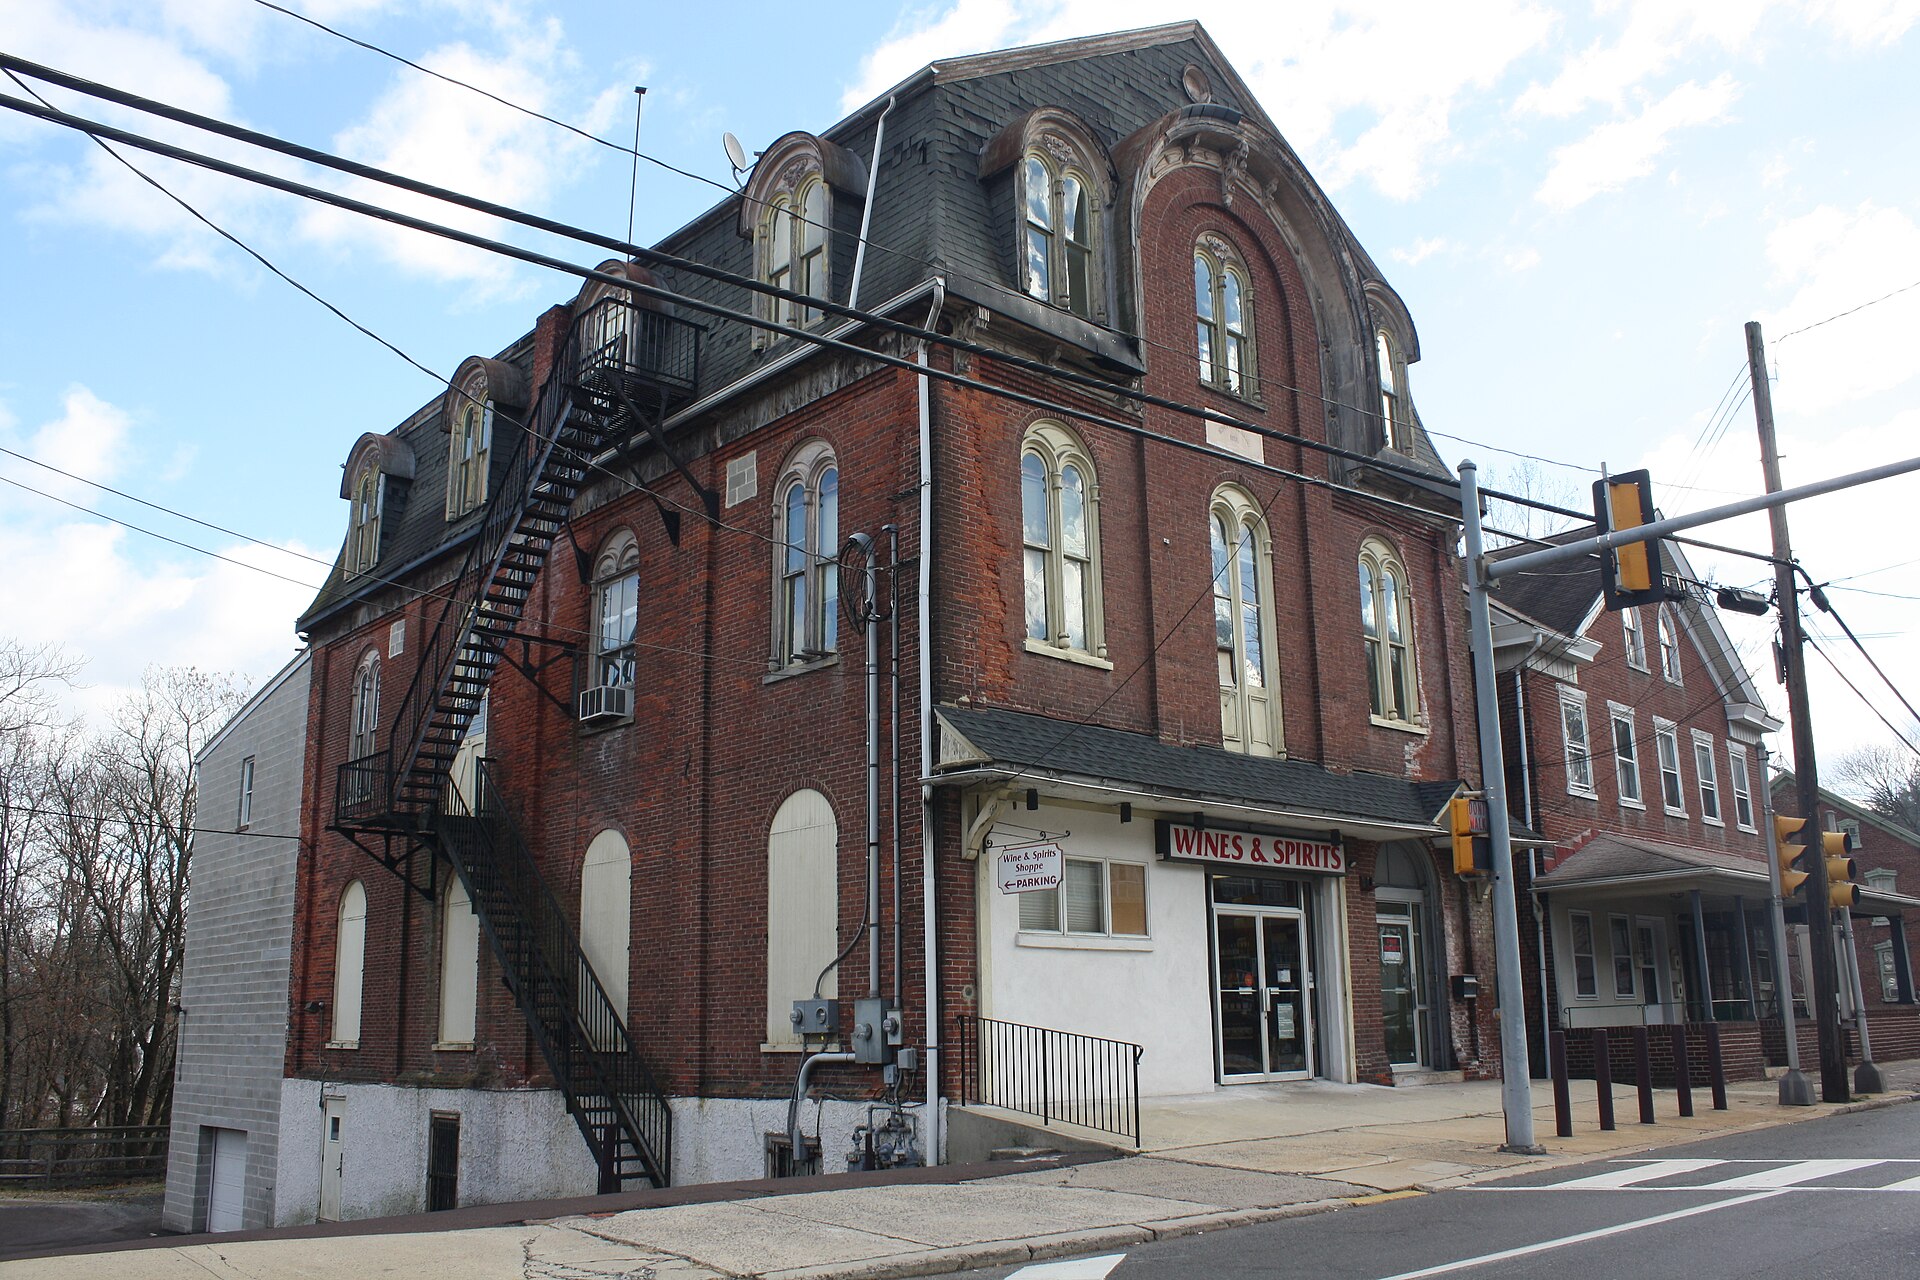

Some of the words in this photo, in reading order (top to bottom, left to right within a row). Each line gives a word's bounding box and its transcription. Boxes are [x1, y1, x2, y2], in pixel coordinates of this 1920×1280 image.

[1173, 827, 1244, 861] WINES
[1250, 837, 1268, 863] &
[1273, 839, 1342, 870] SPIRITS
[1003, 854, 1022, 863] Wine
[1023, 851, 1030, 860] &
[1032, 850, 1057, 861] Spirits
[1015, 862, 1044, 873] Shoppe
[1016, 875, 1057, 888] PARKING
